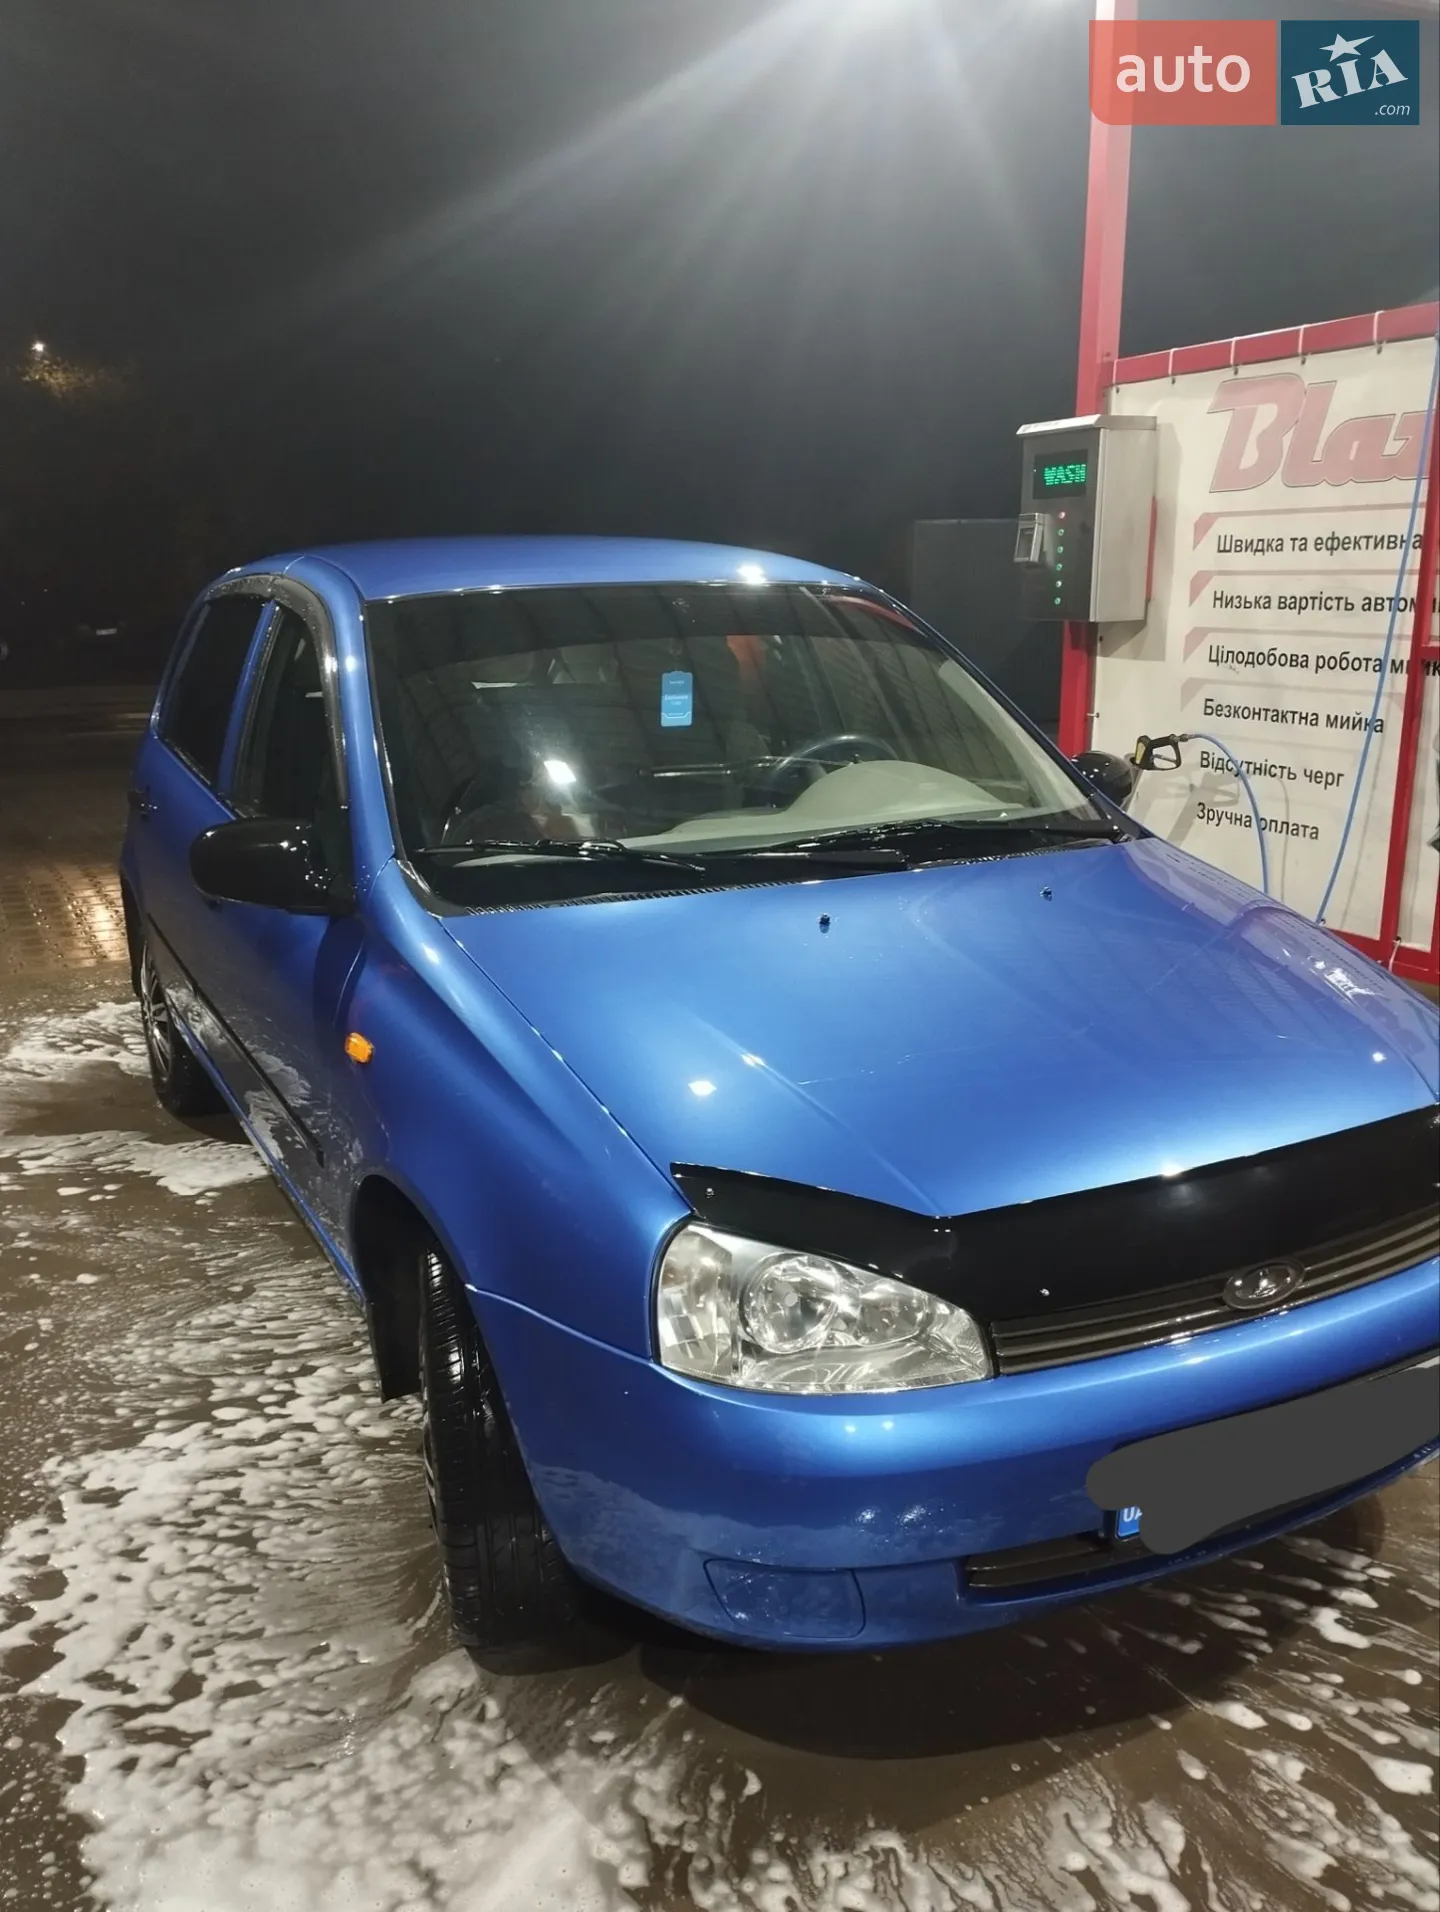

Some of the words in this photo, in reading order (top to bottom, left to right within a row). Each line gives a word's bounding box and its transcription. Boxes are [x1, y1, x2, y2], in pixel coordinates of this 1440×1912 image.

[1217, 534, 1284, 555] Швидка
[1290, 536, 1308, 552] та
[1213, 590, 1271, 610] Низька
[1277, 591, 1355, 615] вартість
[1208, 645, 1309, 670] Цілодобова
[1315, 651, 1382, 673] робота
[1203, 698, 1319, 727] Безконтактна
[1303, 769, 1345, 790] черг
[1196, 802, 1252, 828] Зручна
[1260, 817, 1319, 840] оплата
